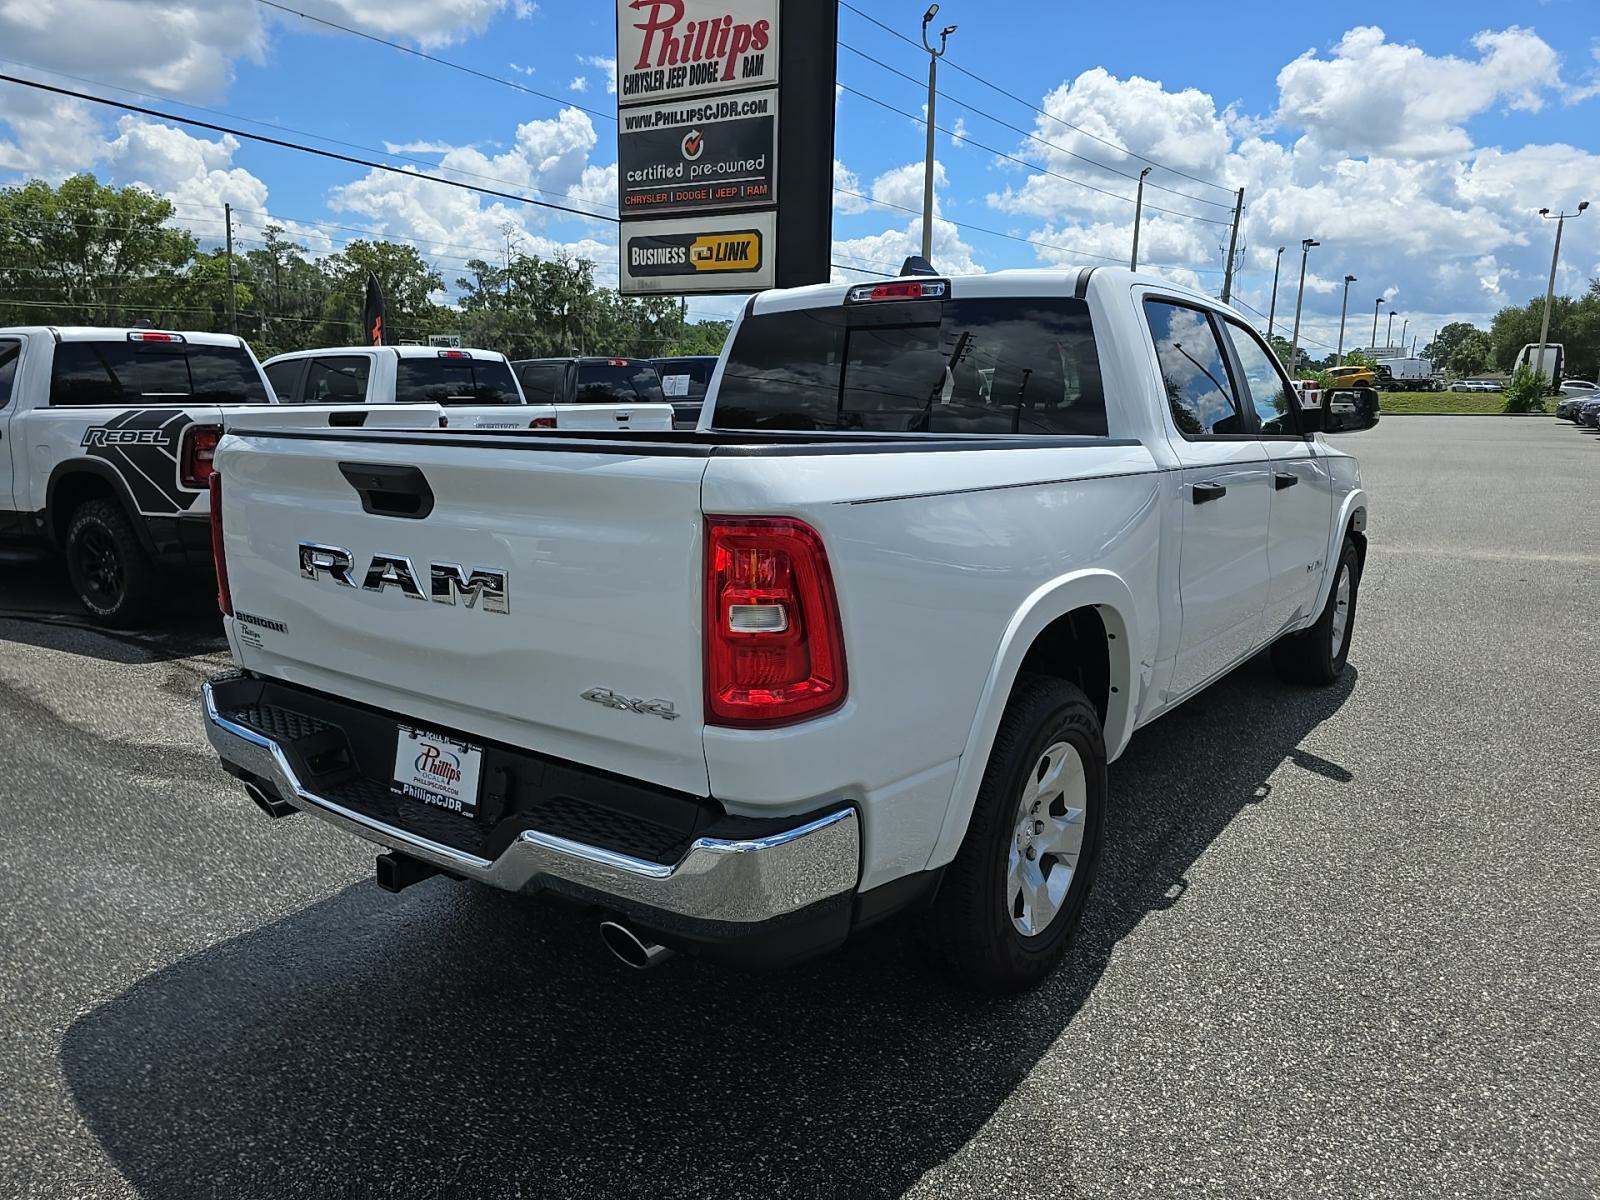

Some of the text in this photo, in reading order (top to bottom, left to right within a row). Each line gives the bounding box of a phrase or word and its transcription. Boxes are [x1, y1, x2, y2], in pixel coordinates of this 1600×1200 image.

[629, 0, 770, 81] Phillips
[623, 54, 764, 95] CHRYSLER JEEP DODGE RAM
[627, 154, 765, 182] certified pre-owned
[624, 185, 768, 204] CHRYSLER DODGE JEEP RAM
[631, 241, 751, 266] BUSINESS LINK
[82, 427, 170, 447] REBEL
[299, 541, 510, 615] RAM
[420, 742, 461, 785] Phillips
[422, 772, 446, 784] OCALA
